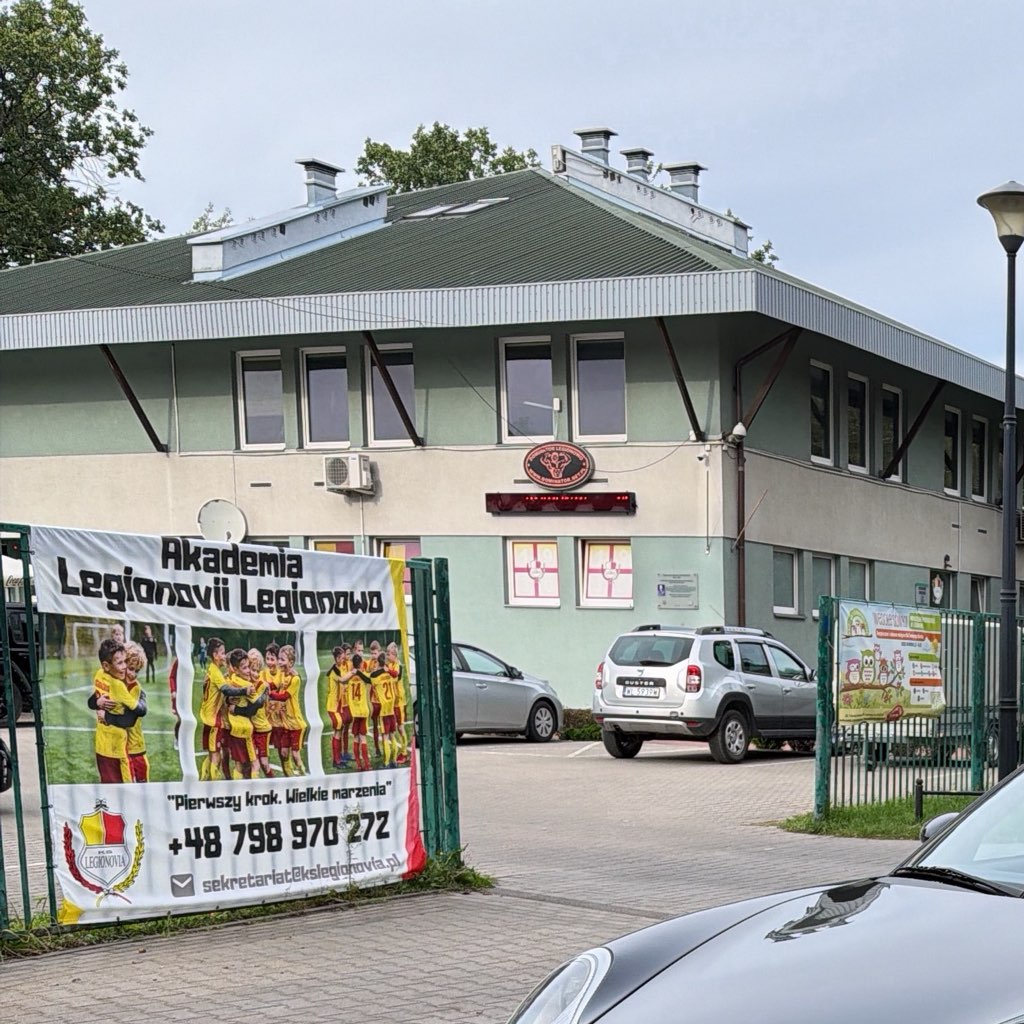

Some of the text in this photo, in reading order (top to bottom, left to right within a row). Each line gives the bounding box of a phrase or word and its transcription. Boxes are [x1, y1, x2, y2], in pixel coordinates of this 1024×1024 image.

[161, 537, 303, 578] Akademia
[57, 556, 384, 624] Legionovii Legionowo
[352, 683, 361, 701] 14
[167, 781, 392, 812] "Pierwszy krok. Wielkie marzenia"
[168, 810, 390, 859] +48 798 970 272
[85, 854, 126, 869] LEGIONOVIA
[202, 853, 400, 893] sekretariat@kslegionovia.pl
